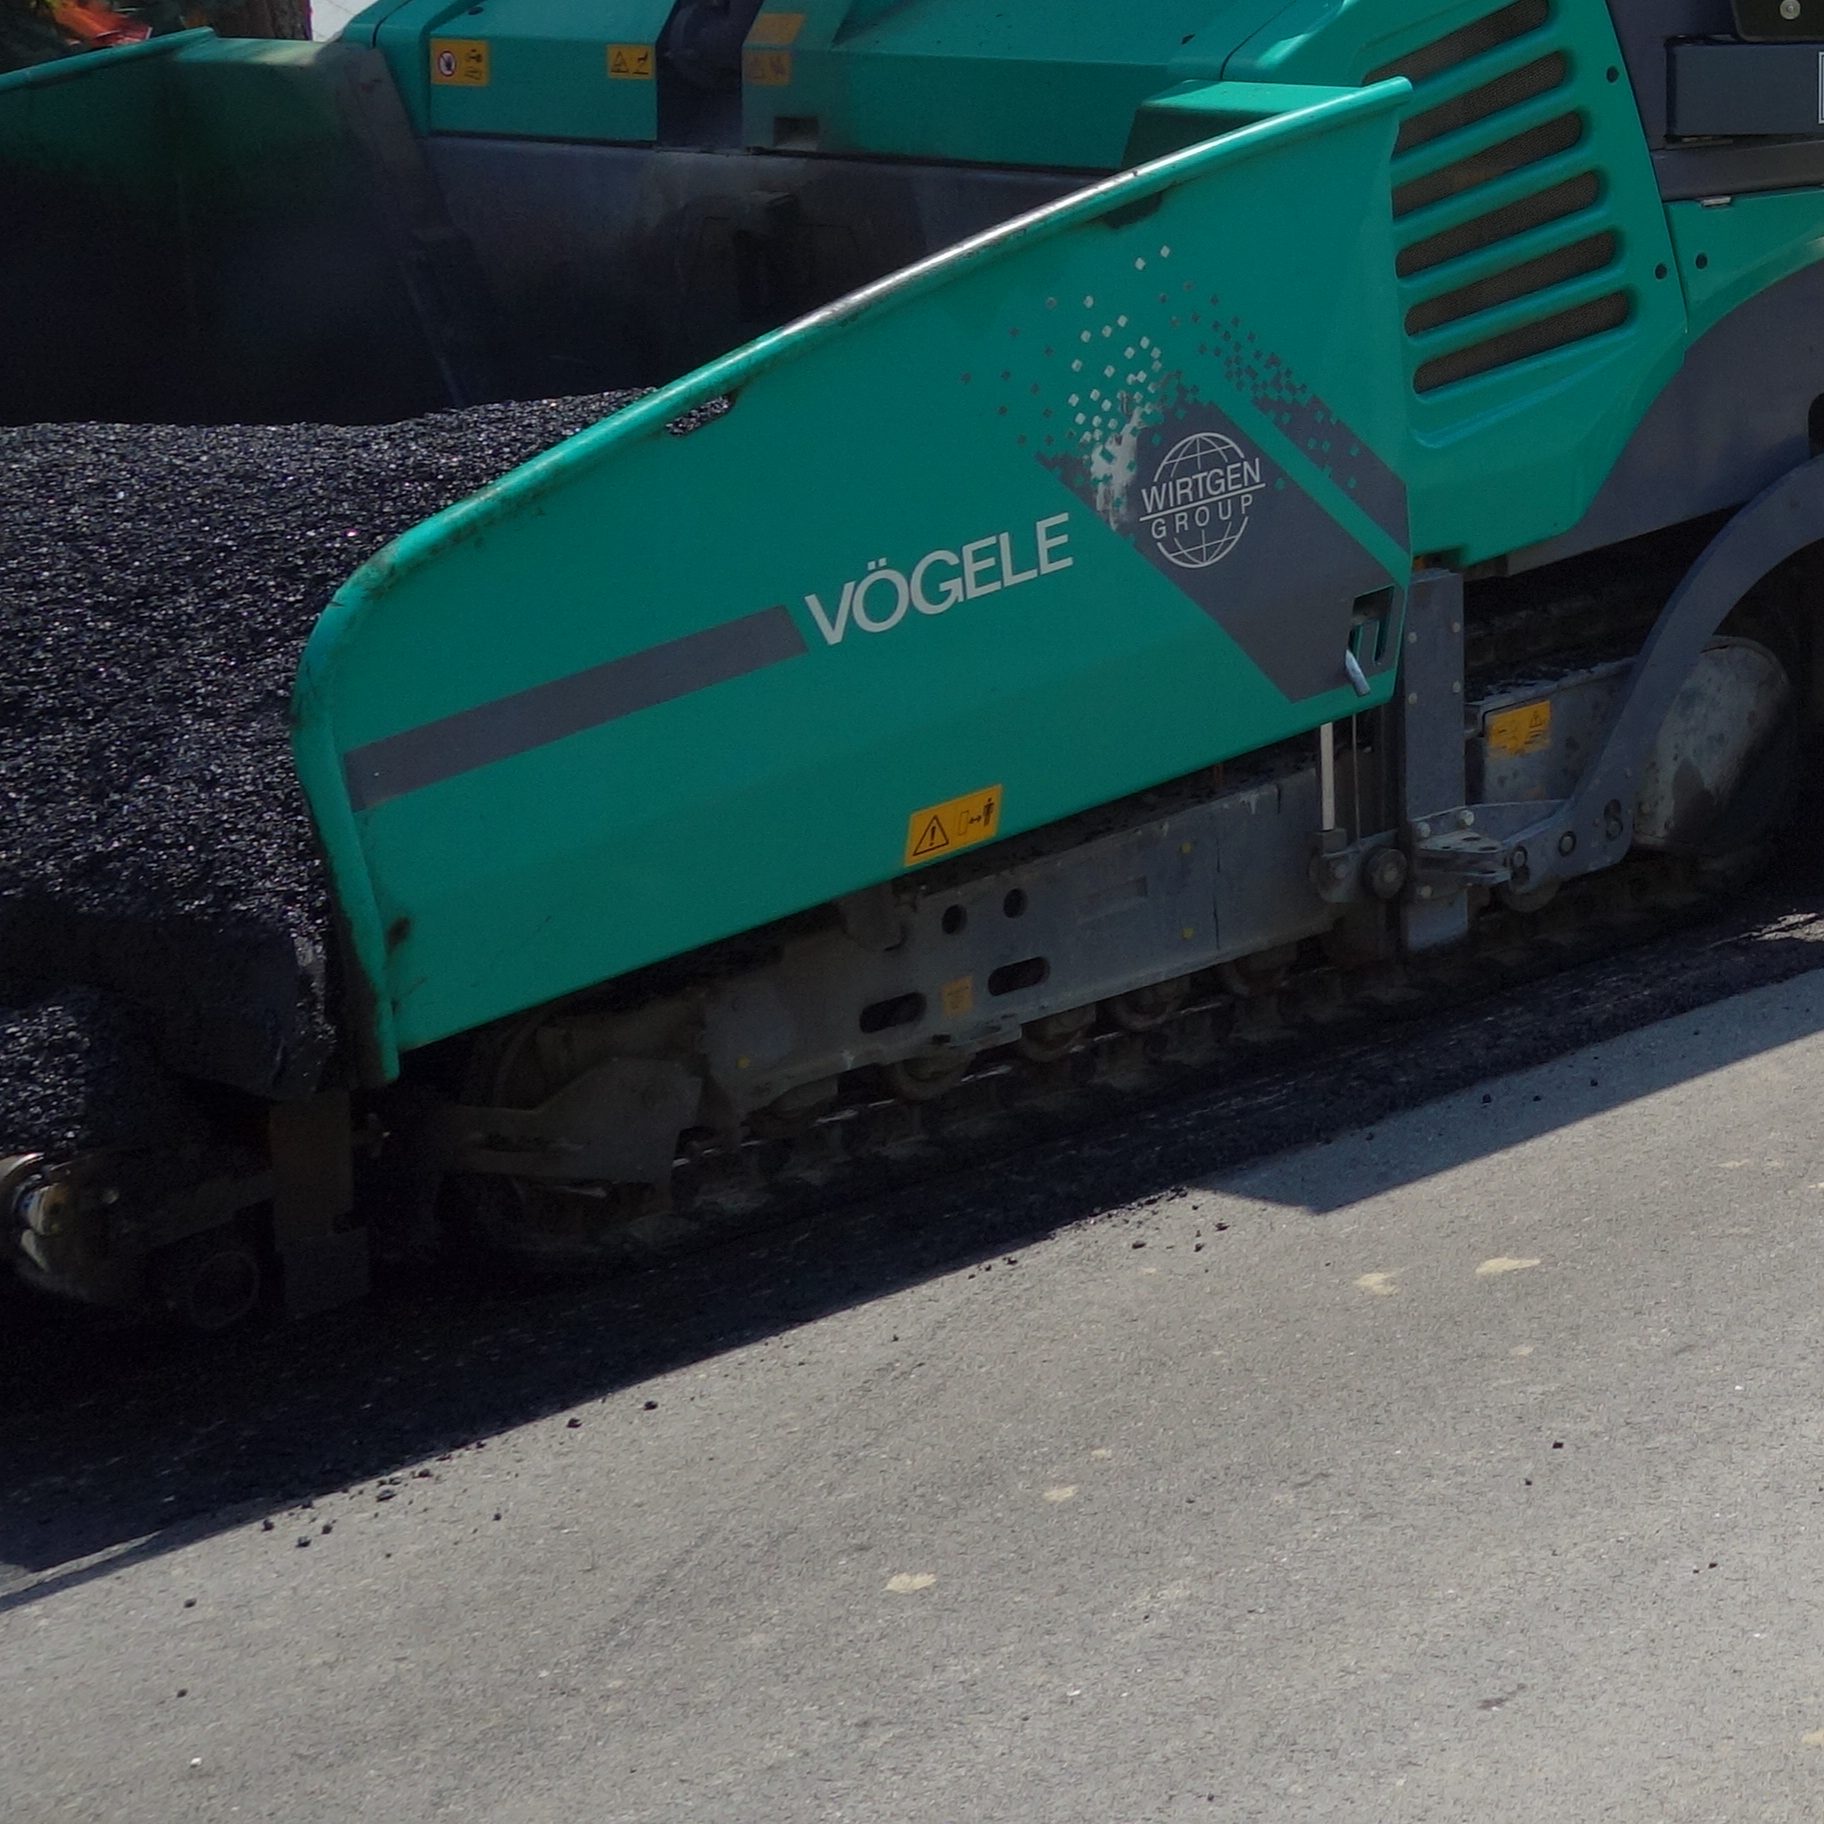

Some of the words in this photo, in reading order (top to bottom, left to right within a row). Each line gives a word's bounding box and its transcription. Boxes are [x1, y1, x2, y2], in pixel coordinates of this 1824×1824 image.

[1141, 457, 1261, 514] WIRTGEN
[1151, 493, 1253, 540] GROUP
[803, 511, 1074, 646] VÖGELE
